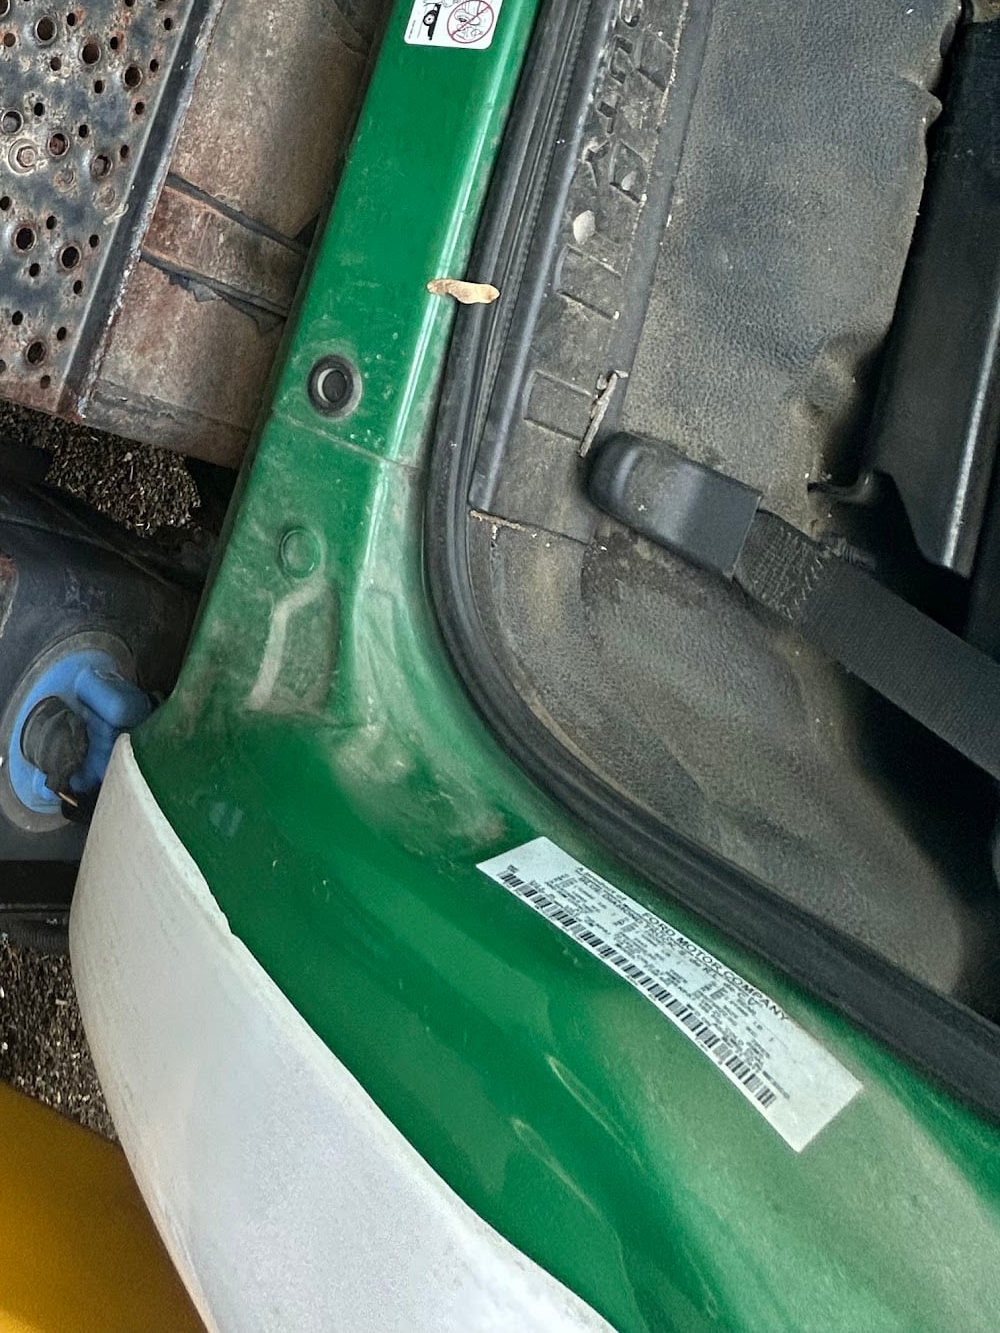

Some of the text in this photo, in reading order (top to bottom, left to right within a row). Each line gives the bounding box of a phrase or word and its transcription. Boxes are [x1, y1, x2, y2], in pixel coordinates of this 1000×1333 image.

[642, 912, 676, 937] FORD
[677, 937, 723, 972] MOTOR
[723, 971, 789, 1021] COMPANY
